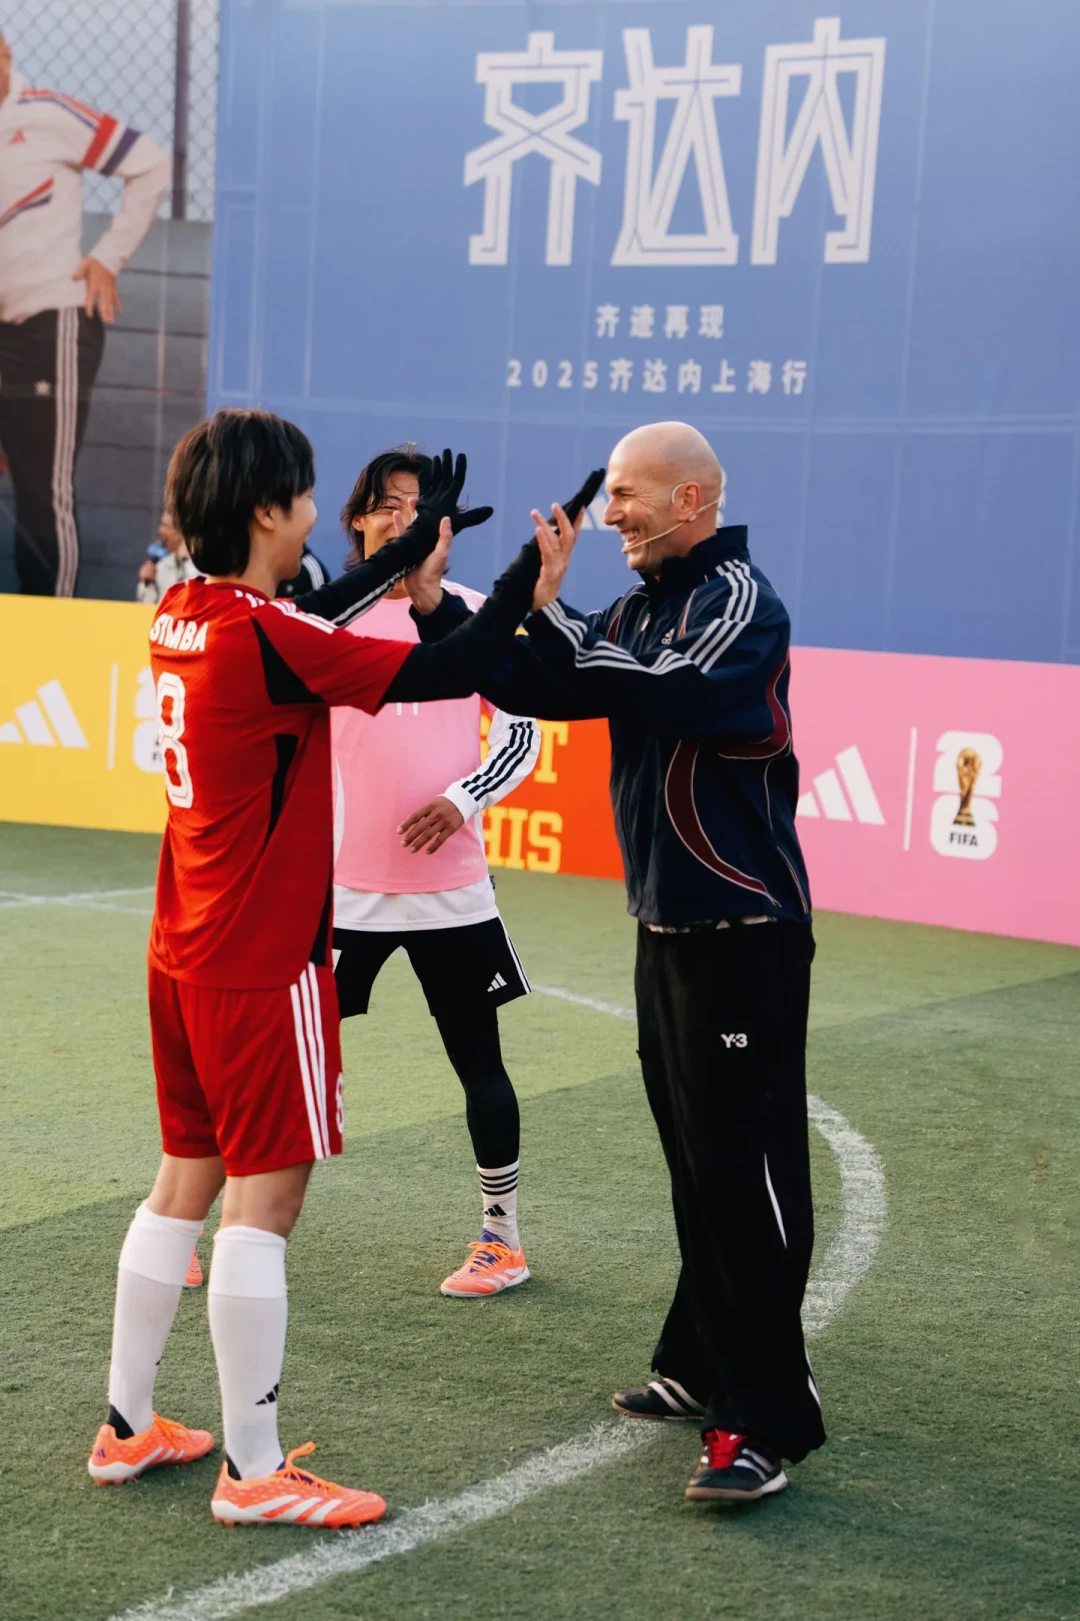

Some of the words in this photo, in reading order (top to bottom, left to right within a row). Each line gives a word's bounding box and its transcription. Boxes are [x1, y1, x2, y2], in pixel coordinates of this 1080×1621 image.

[463, 17, 886, 266] 齐达内
[149, 612, 209, 652] SIMBA
[157, 671, 194, 809] 8
[949, 831, 979, 847] FIFA
